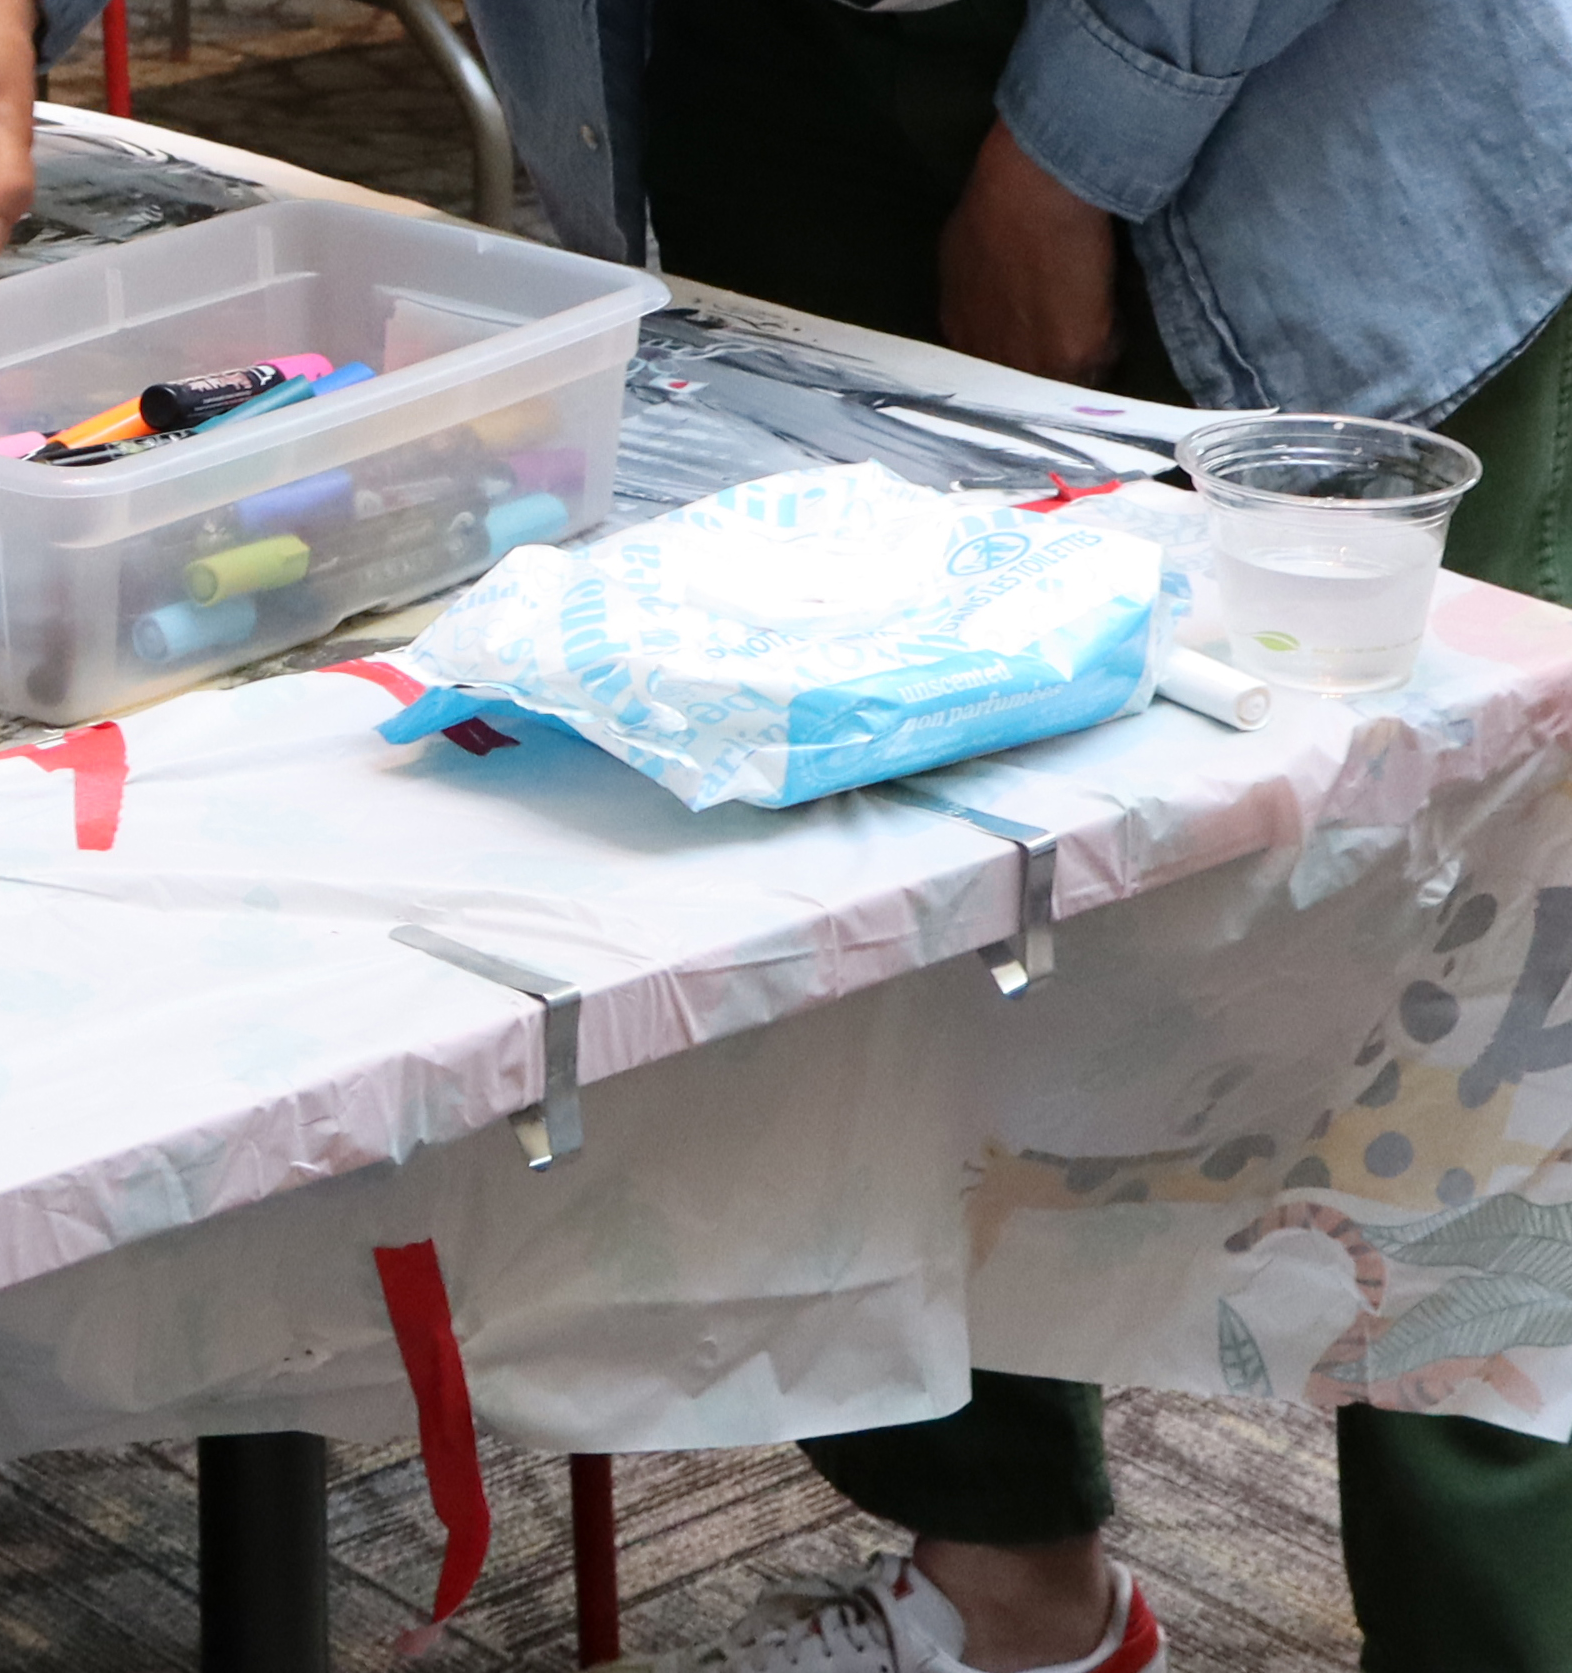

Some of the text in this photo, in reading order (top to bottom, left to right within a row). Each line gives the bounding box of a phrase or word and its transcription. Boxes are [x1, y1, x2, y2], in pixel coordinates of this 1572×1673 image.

[939, 529, 1103, 633] DANS LES TOILETTES
[899, 658, 1009, 703] unscented
[902, 681, 1063, 732] non parfumées
